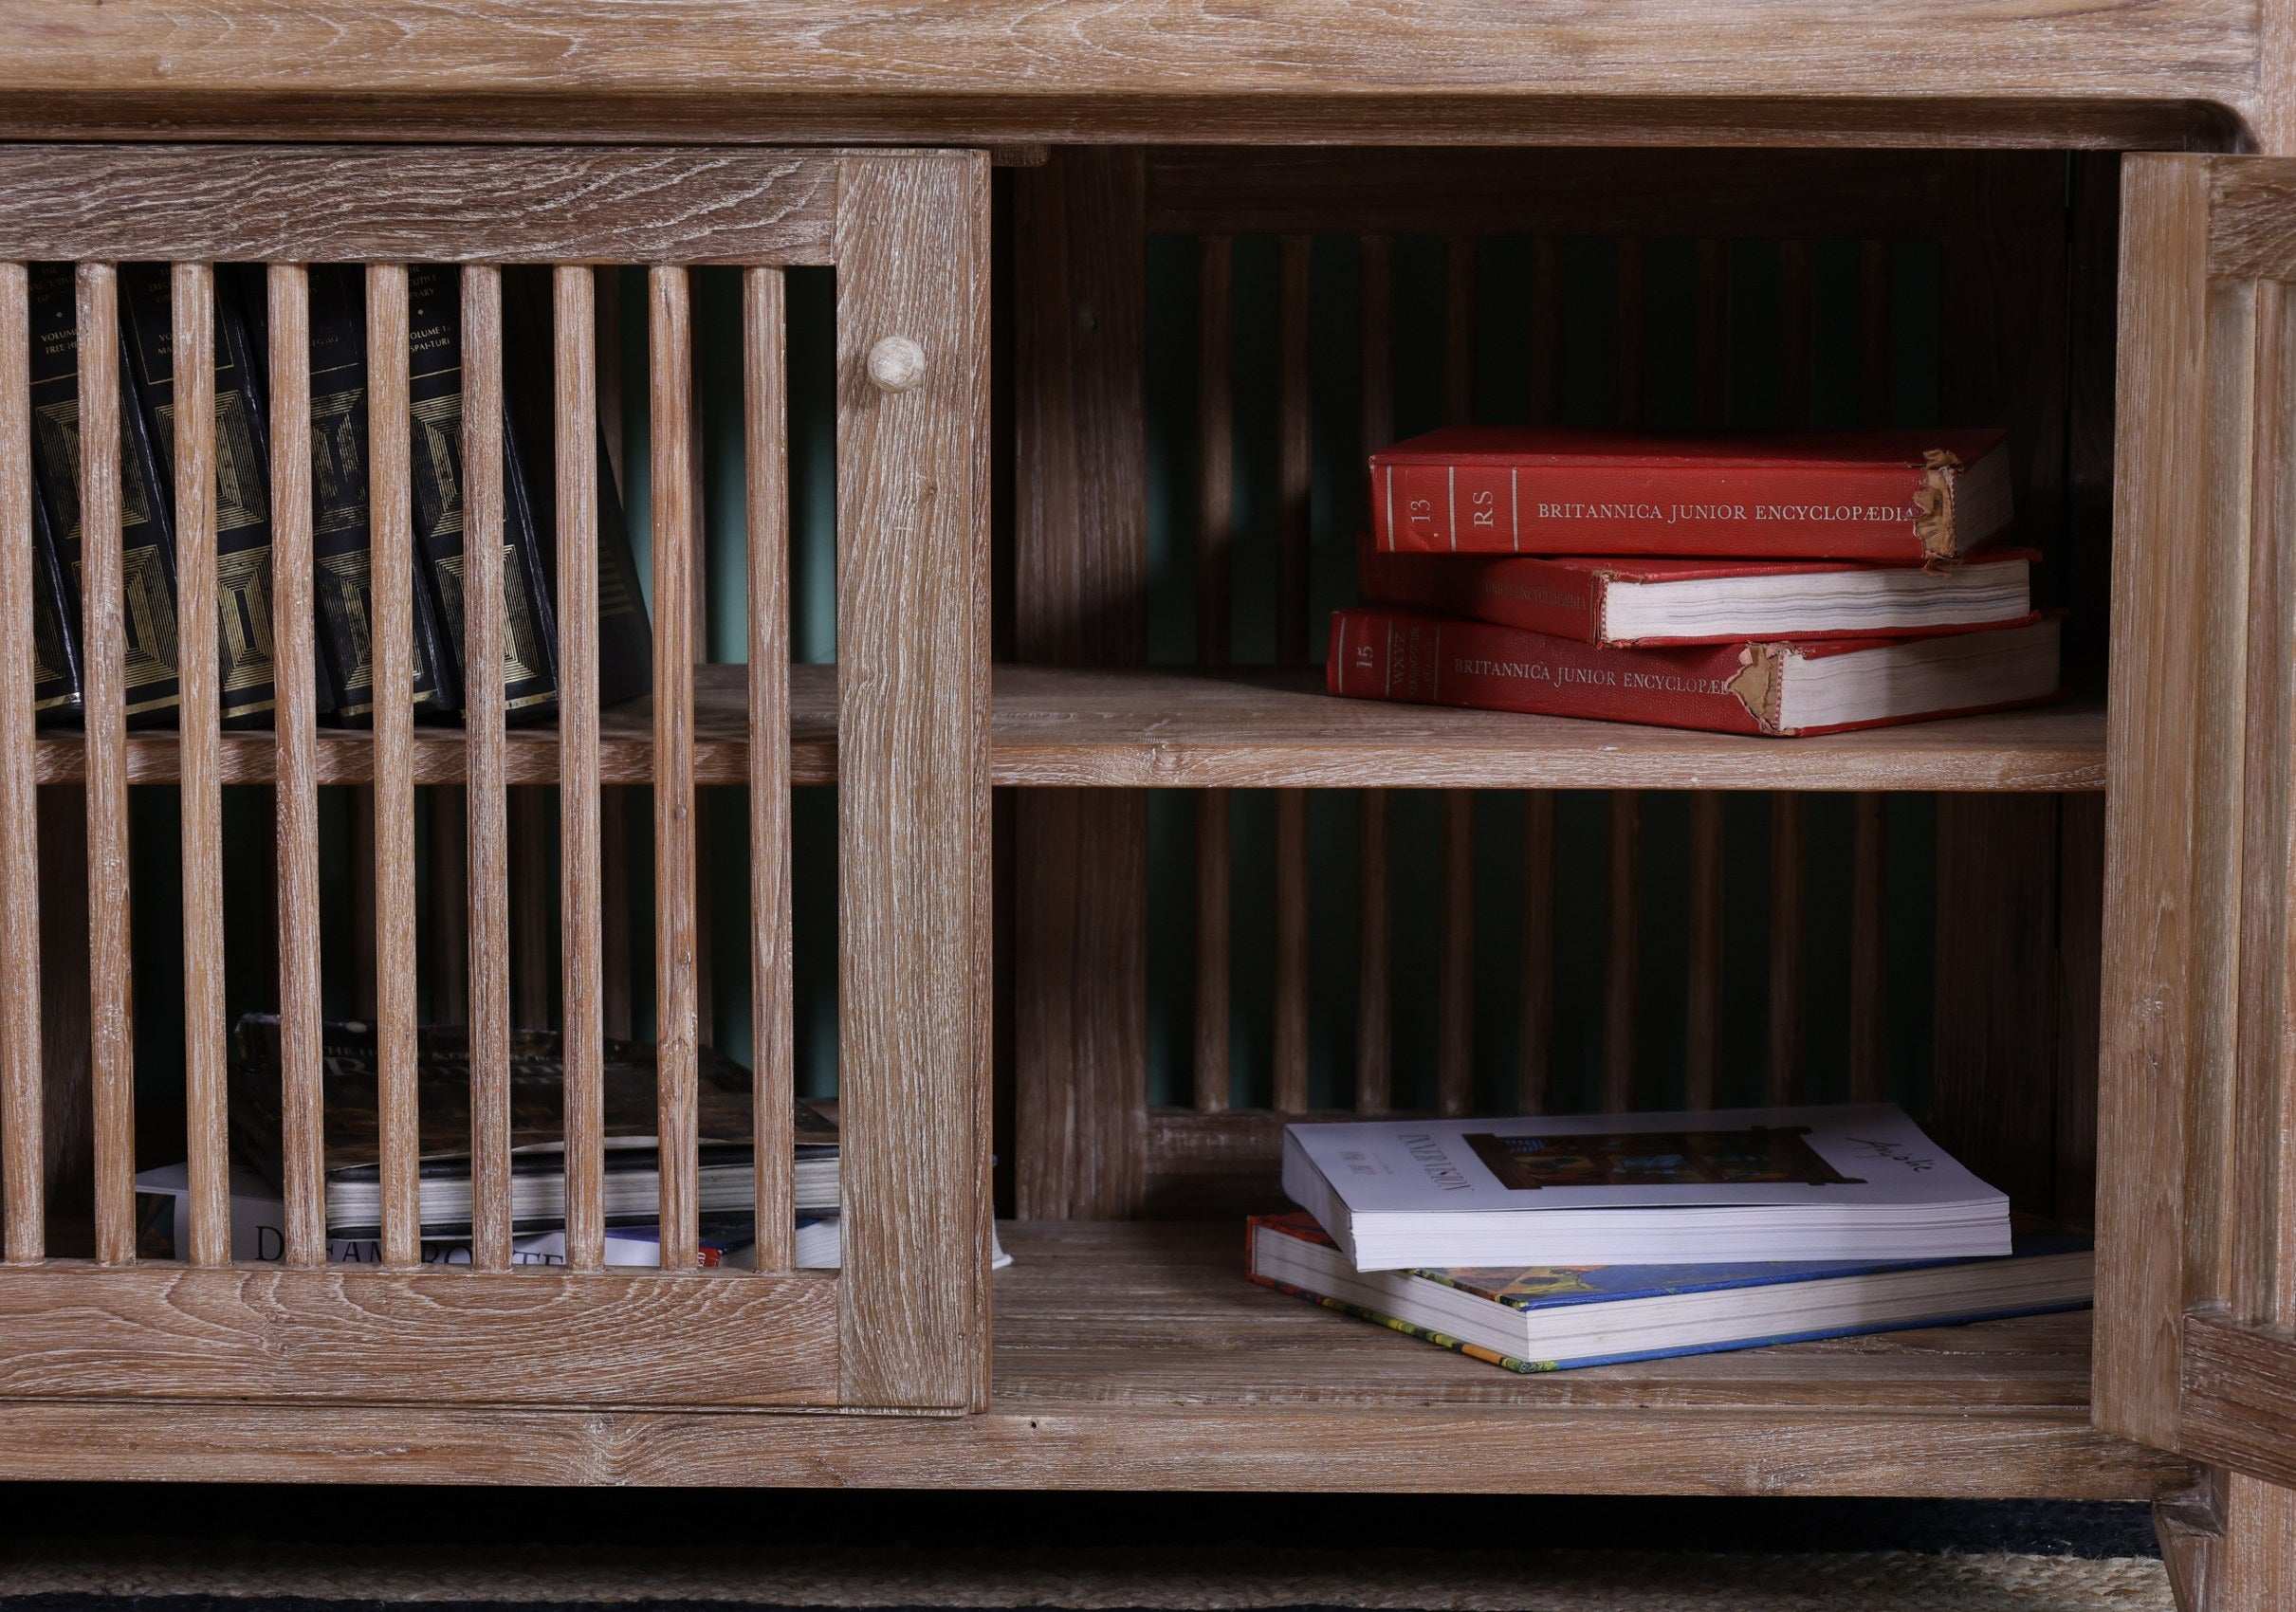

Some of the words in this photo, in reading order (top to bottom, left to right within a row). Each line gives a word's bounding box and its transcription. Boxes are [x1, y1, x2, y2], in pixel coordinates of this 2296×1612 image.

[41, 327, 76, 342] VOLUM
[410, 325, 440, 340] OLUME
[46, 339, 76, 356] FREE-H
[1410, 499, 1431, 523] 13
[1538, 504, 1663, 520] BRITANNICA
[1668, 504, 1747, 523] JUNIOR
[1356, 645, 1373, 669] 15
[1455, 658, 1551, 681] BRITANNICA
[1553, 667, 1616, 688] JUNIOR
[1623, 671, 1729, 695] ENCYCLOPÆ
